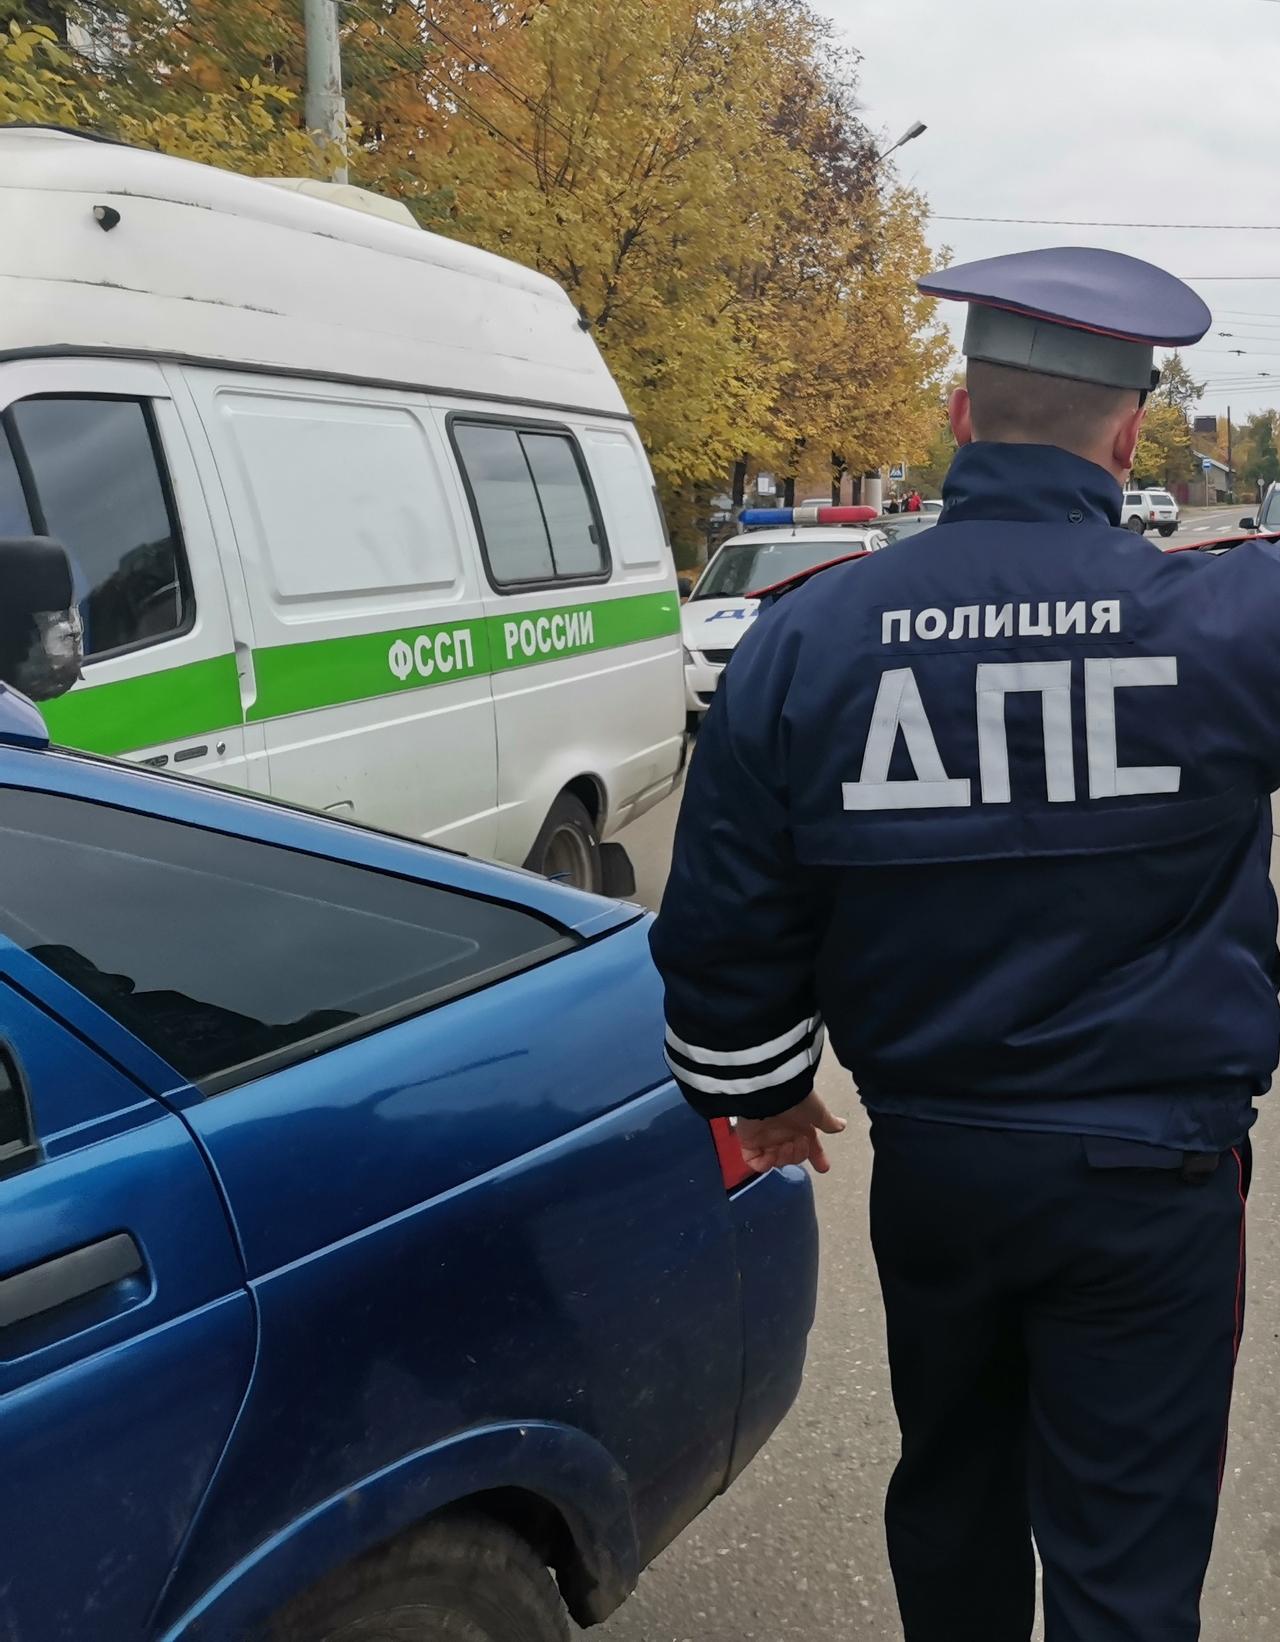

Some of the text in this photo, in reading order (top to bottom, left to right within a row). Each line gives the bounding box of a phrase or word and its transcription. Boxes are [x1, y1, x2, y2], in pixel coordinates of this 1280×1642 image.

[388, 610, 595, 681] ФССП РОССИИ
[881, 599, 1121, 645] ПОЛИЦИЯ
[841, 656, 1182, 811] ДПС
